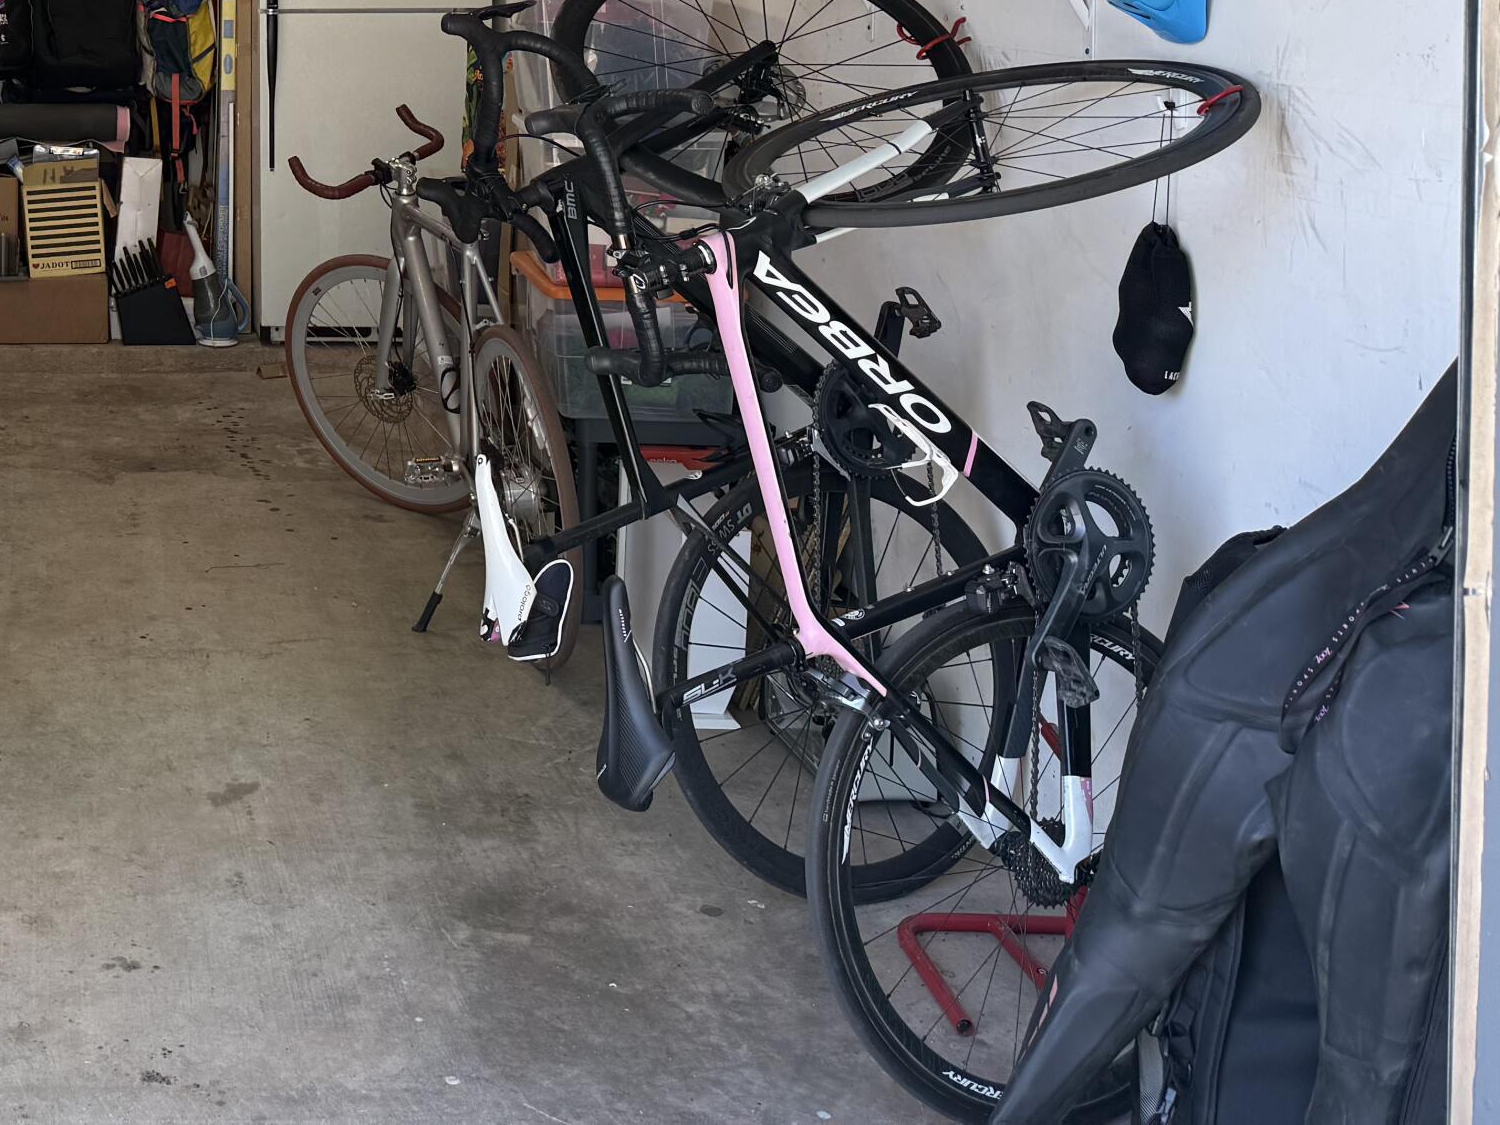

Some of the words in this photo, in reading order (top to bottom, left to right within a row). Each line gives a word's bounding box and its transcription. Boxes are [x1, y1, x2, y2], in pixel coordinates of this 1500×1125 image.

[836, 90, 919, 118] MERCURY
[563, 179, 578, 220] BMC
[39, 260, 70, 270] JADOT
[752, 250, 952, 434] ORBEA
[737, 502, 752, 525] DT
[516, 584, 532, 621] prologo
[942, 1070, 1004, 1100] ERCURY
